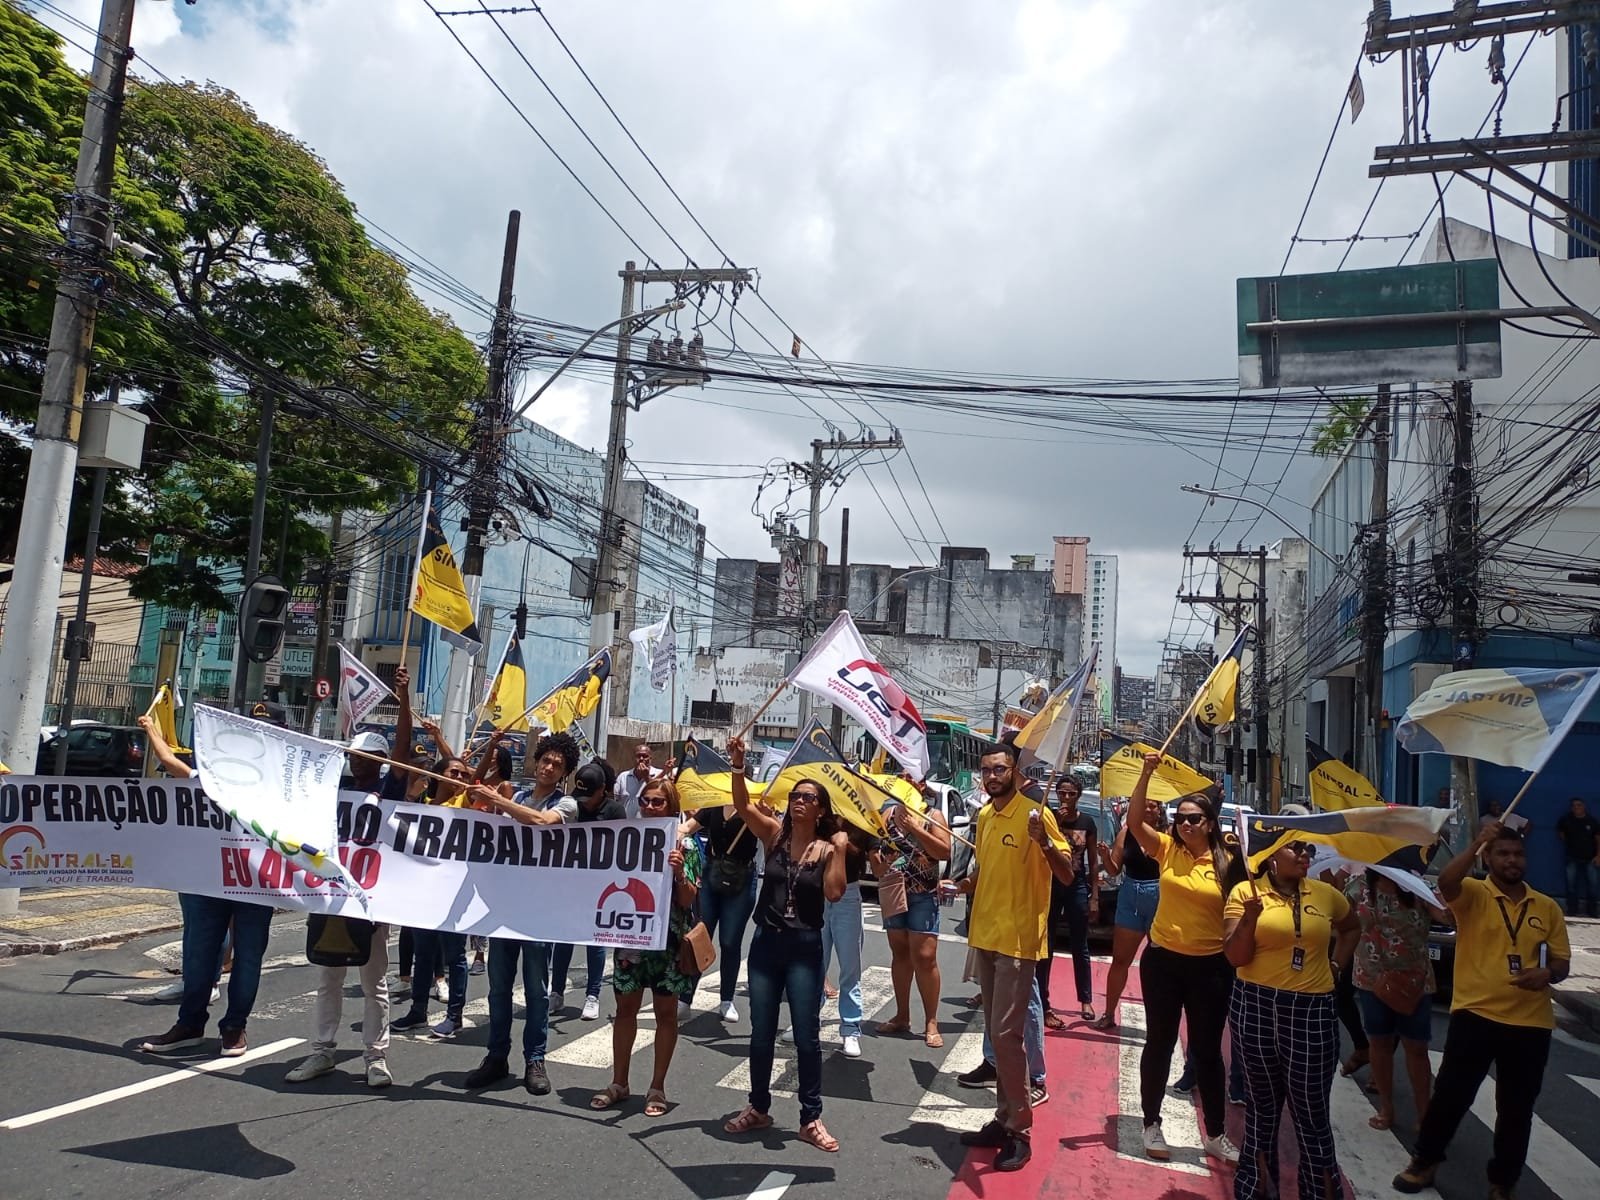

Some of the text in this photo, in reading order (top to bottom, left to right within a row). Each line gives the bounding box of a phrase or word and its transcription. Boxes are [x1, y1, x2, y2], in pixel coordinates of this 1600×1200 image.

[837, 667, 924, 738] UGT
[1204, 702, 1217, 722] BA
[1122, 747, 1180, 771] SINAL
[820, 762, 868, 818] SINTRAL
[0, 778, 168, 831] OPERAÇÃO
[392, 811, 666, 873] TRABALHADOR
[46, 876, 73, 885] AQUI
[87, 875, 135, 883] TRABALHO
[220, 846, 252, 888] EU
[595, 910, 655, 934] UGT
